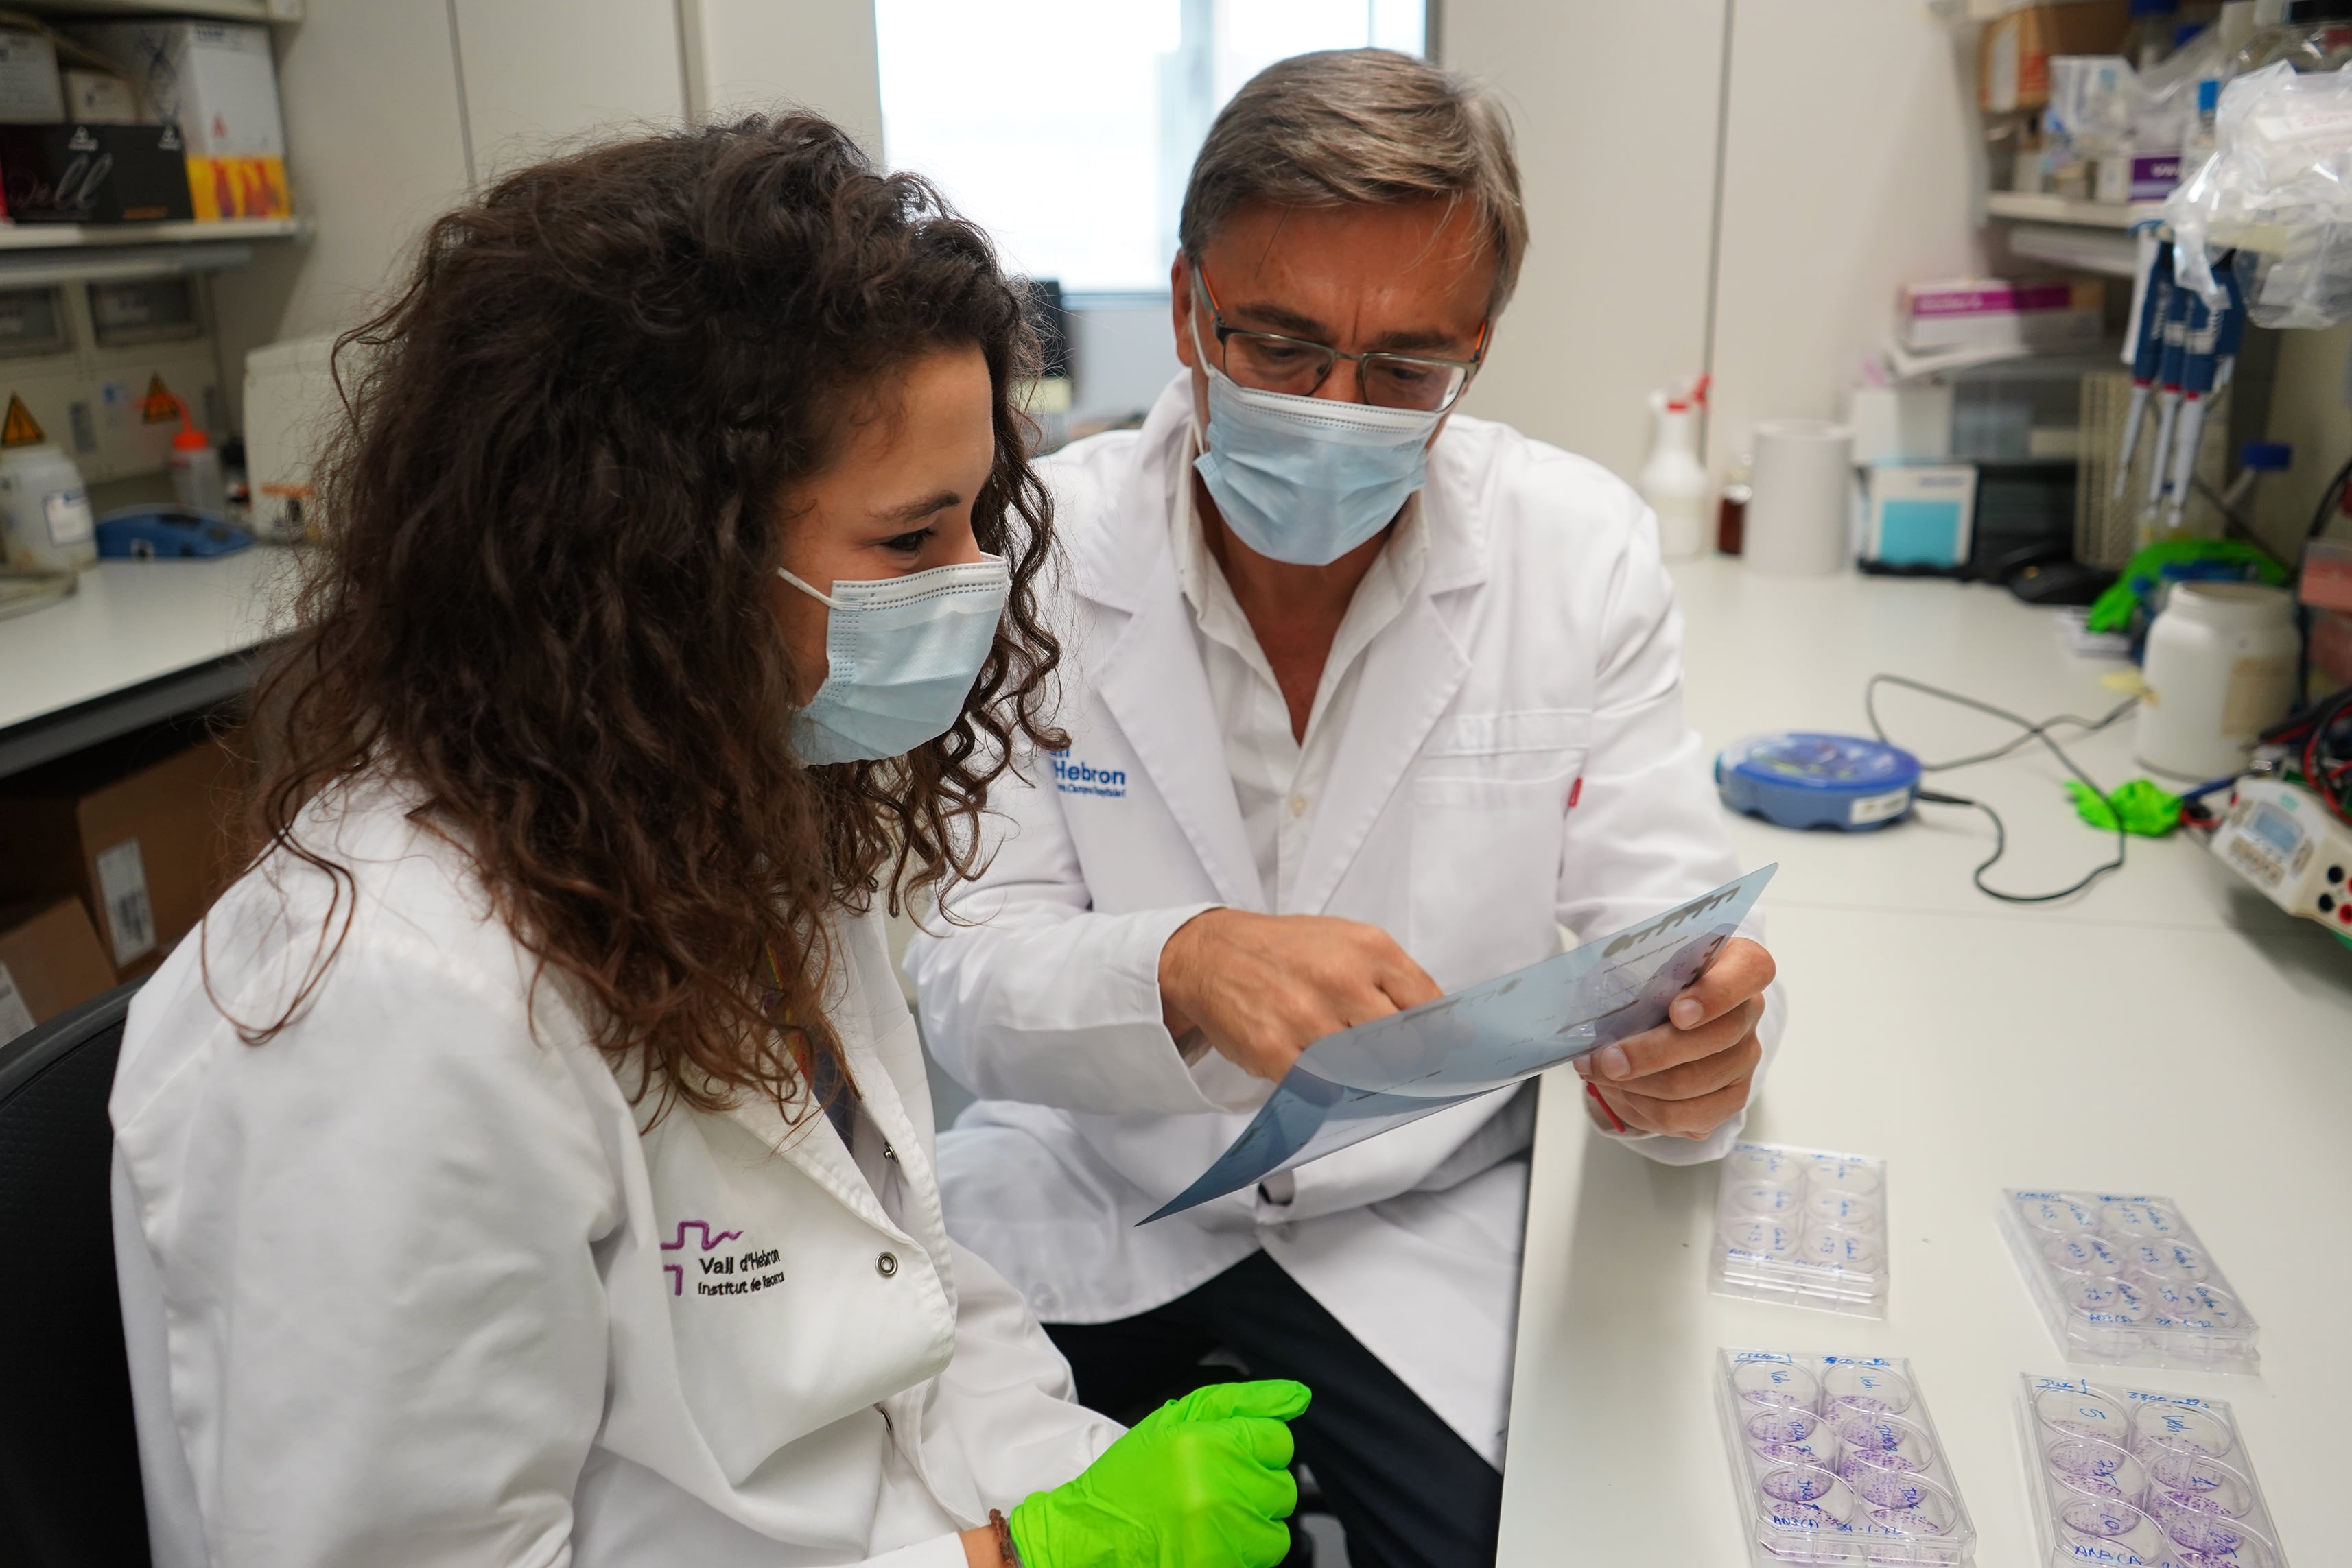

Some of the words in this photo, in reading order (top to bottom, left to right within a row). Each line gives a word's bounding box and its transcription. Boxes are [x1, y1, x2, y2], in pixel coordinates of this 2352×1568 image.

[698, 1257, 733, 1274] Vall
[698, 1281, 748, 1296] Institut
[750, 1278, 761, 1292] de
